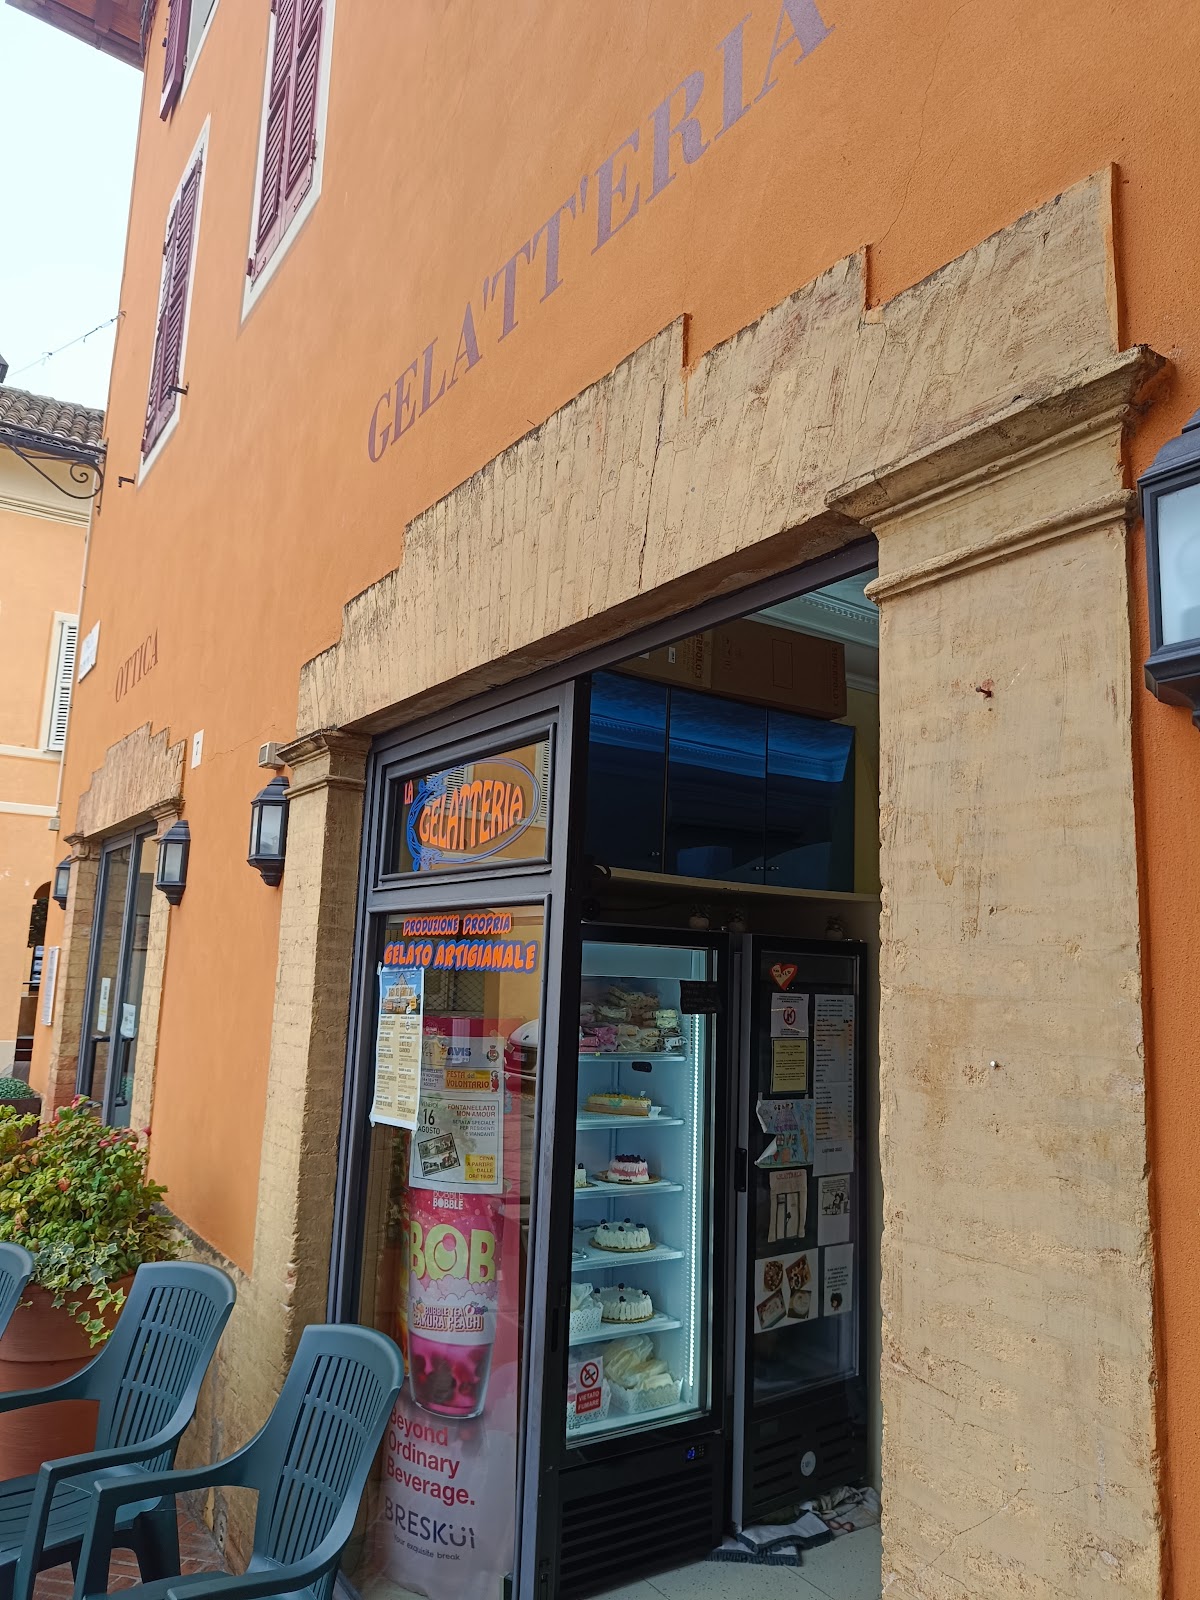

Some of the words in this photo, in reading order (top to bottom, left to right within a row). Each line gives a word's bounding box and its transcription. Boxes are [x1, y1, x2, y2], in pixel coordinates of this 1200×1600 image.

[367, 0, 836, 463] GELATTERIA
[115, 627, 159, 703] OTTICA
[404, 780, 413, 805] LA
[419, 779, 524, 850] GELATTERIA
[403, 915, 459, 936] PRODUZIONE
[463, 913, 512, 934] PROPRIA
[383, 942, 433, 967] GELATO
[435, 942, 537, 970] ARTIGIANALE
[447, 1046, 472, 1057] AVIS
[446, 1070, 465, 1078] FESTA
[446, 1080, 490, 1089] VOLONTARIO
[423, 1108, 435, 1126] 16
[418, 1125, 441, 1135] AGOSTO
[410, 1220, 496, 1283] BOB
[425, 1306, 449, 1317] BUBBLE
[449, 1307, 465, 1318] TEA
[447, 1315, 484, 1332] PEACH
[577, 1399, 600, 1410] FUMARE
[578, 1390, 600, 1402] VIETATO
[390, 1407, 448, 1447] Beyond
[388, 1430, 460, 1479] Ordinary
[386, 1456, 476, 1506] Beverage.
[436, 1552, 461, 1561] break
